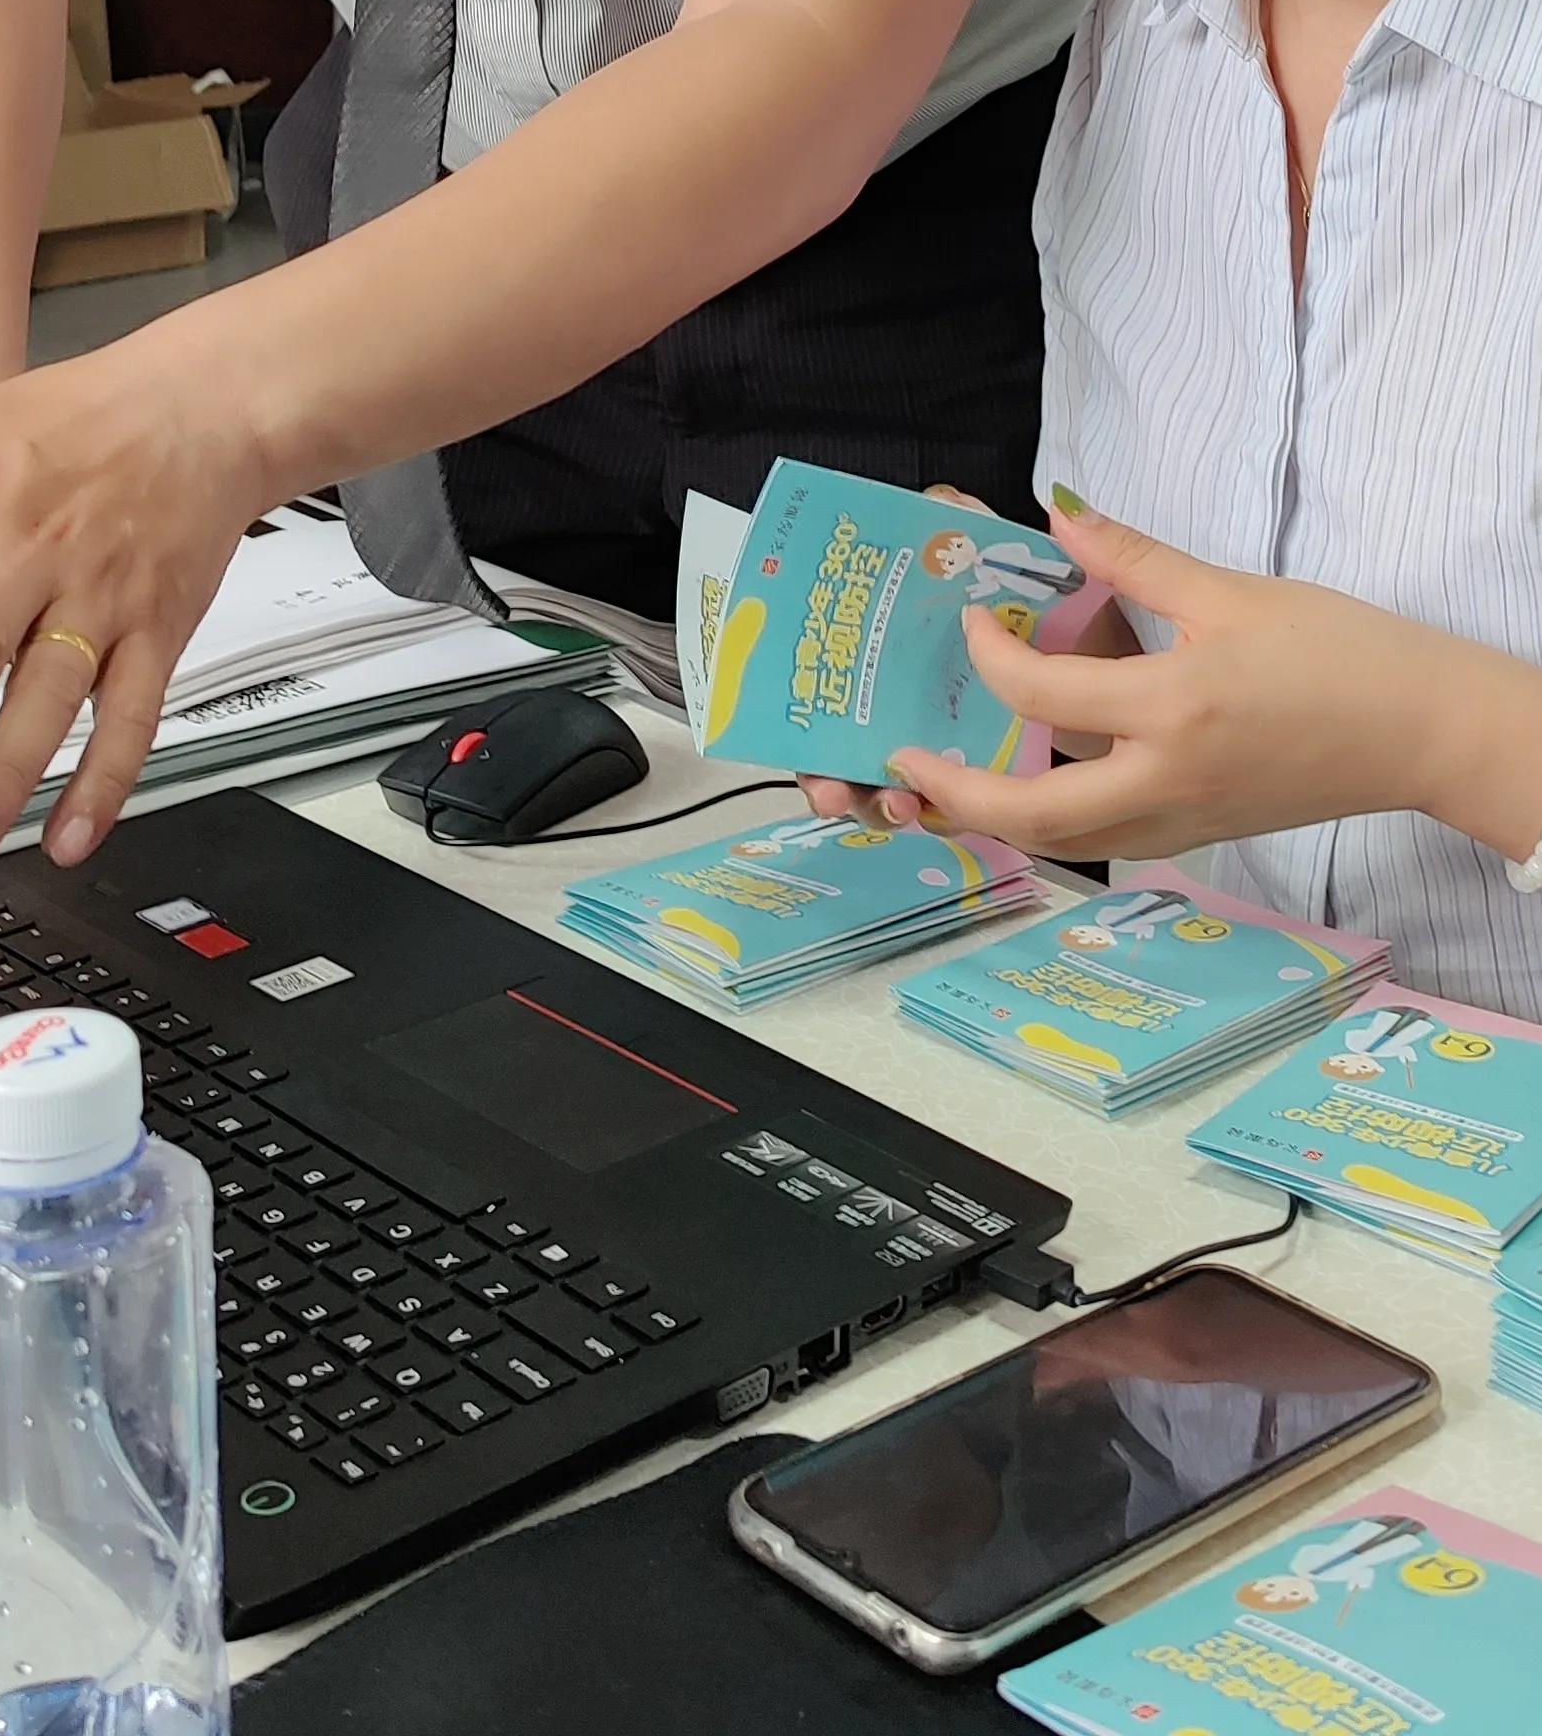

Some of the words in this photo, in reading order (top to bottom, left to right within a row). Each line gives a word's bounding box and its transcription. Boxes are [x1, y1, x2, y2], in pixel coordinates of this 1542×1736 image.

[819, 544, 889, 719] 近视防控
[259, 1144, 284, 1158] N
[302, 1170, 326, 1185] B
[219, 1182, 244, 1197] H
[262, 1209, 285, 1224] G
[306, 1241, 331, 1253] F
[434, 1252, 461, 1269] X
[352, 1267, 376, 1282] D
[256, 1274, 282, 1291] R
[482, 1283, 509, 1299] Z
[398, 1297, 422, 1312] S
[301, 1305, 328, 1321] E
[447, 1327, 472, 1343] A
[342, 1334, 372, 1353] W
[311, 1361, 335, 1376] 2
